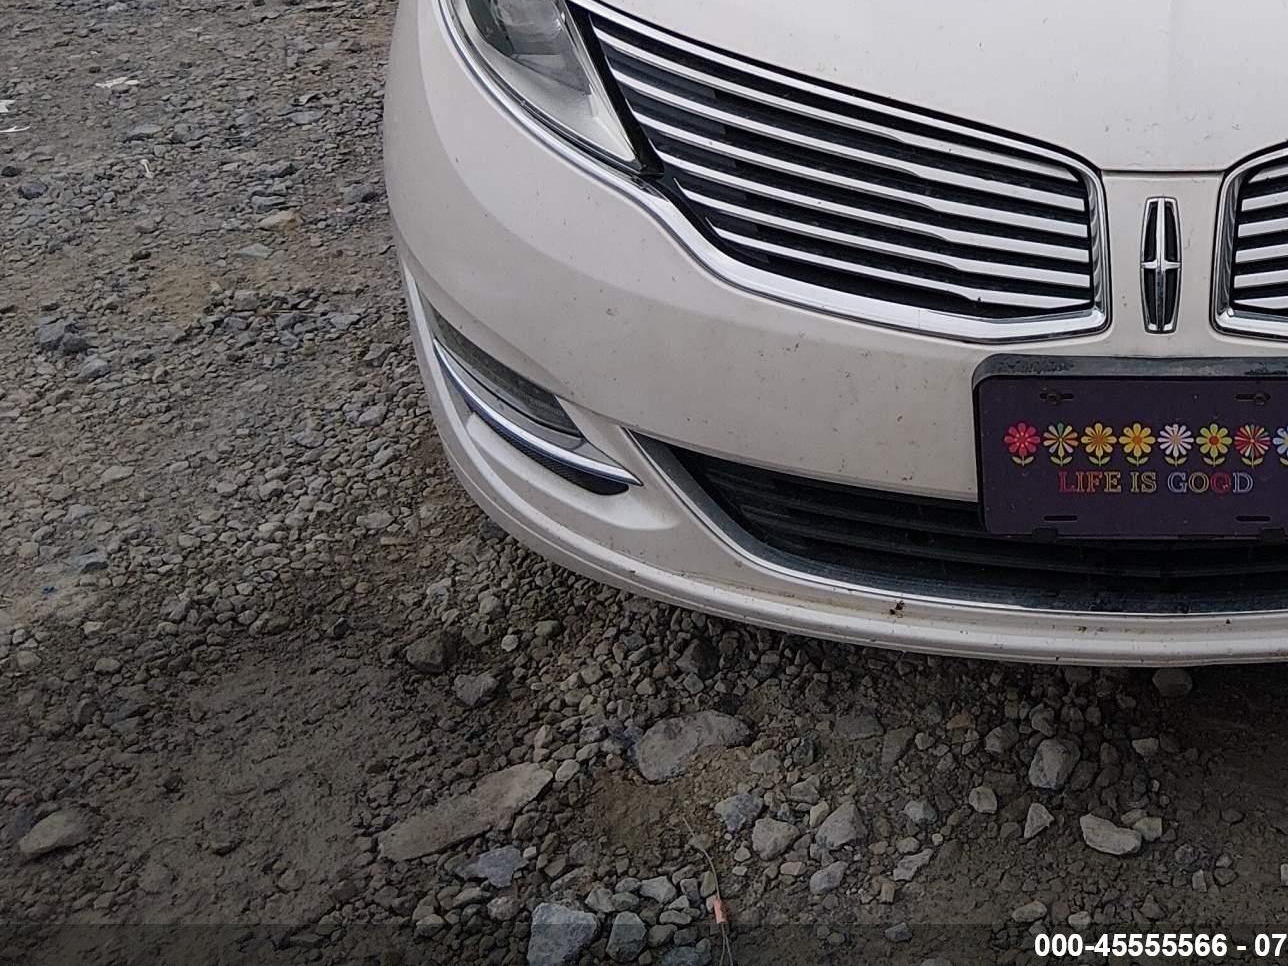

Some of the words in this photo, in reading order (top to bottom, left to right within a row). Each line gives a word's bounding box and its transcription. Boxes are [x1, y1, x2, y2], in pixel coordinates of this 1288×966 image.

[1058, 471, 1122, 493] LIFE
[1130, 471, 1158, 493] IS
[1167, 471, 1254, 493] GOOD
